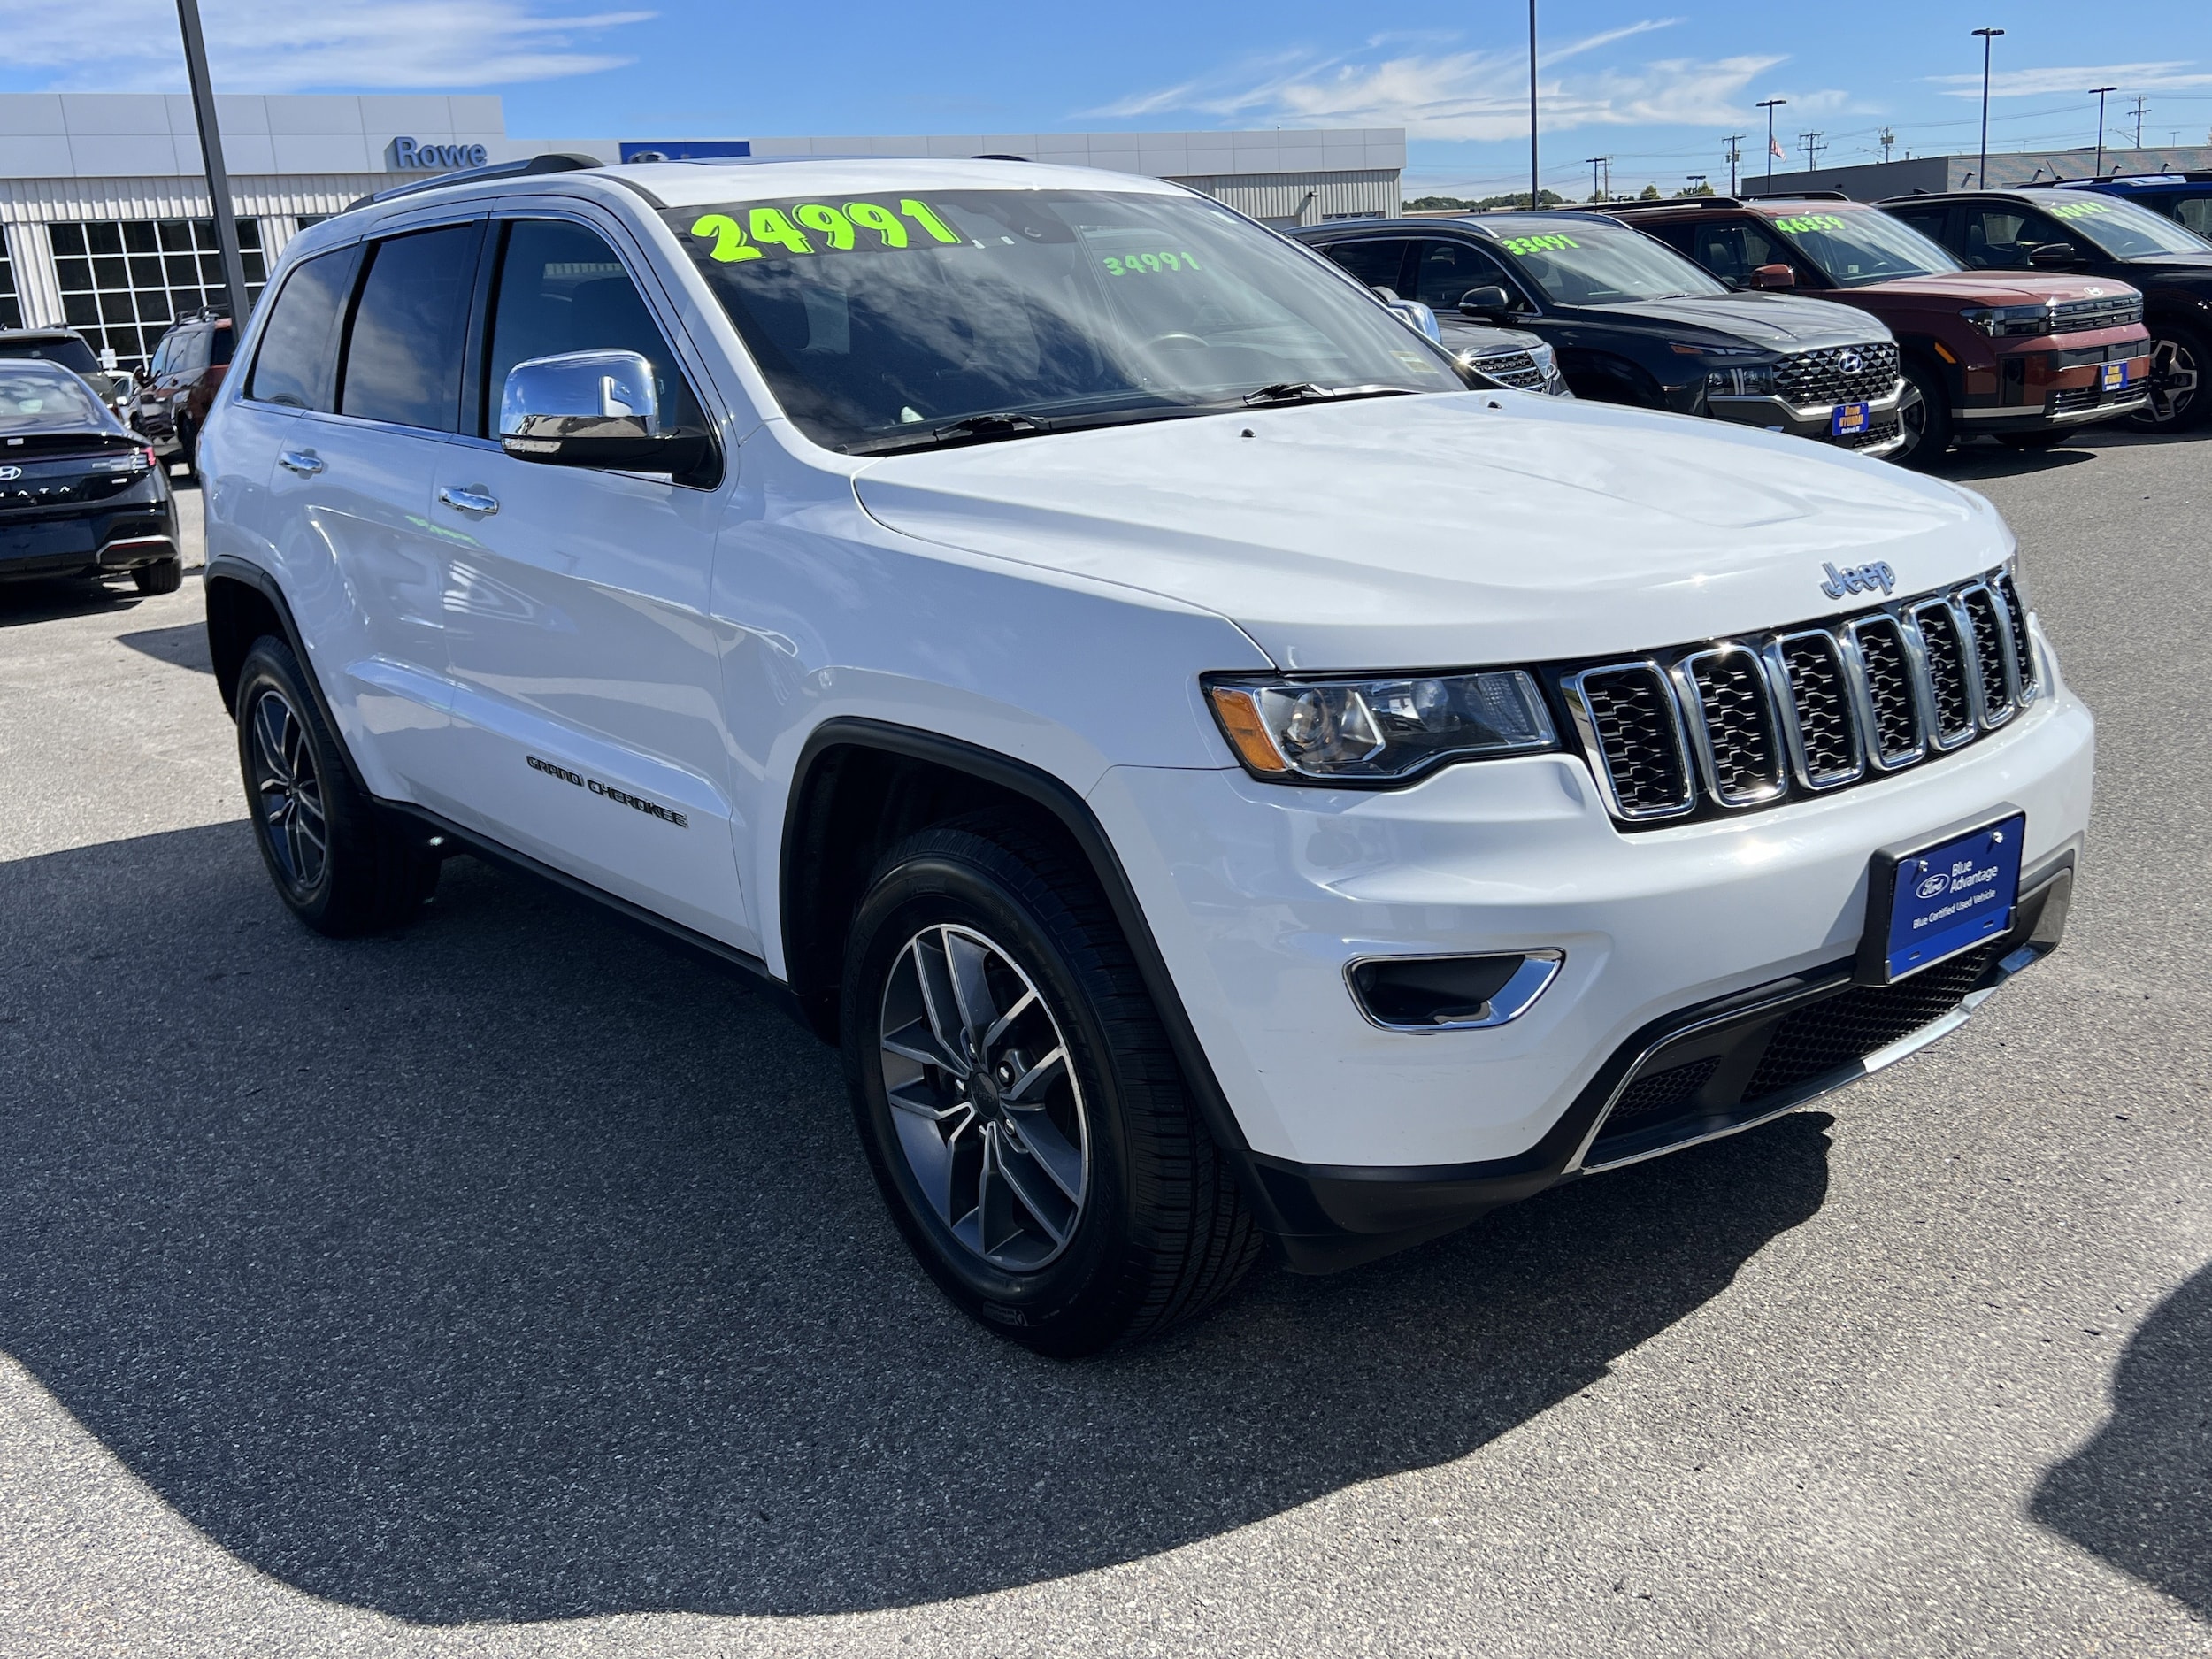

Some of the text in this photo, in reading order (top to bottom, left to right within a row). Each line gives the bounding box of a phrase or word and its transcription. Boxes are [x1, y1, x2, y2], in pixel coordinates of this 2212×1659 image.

[396, 136, 488, 167] Rowe
[690, 198, 962, 265] 24991
[1774, 210, 1847, 234] 46359
[1502, 234, 1580, 256] 33491
[1103, 250, 1202, 276] 34991
[1820, 559, 1895, 599] Jeep
[526, 755, 688, 828] GRAND CHEROKEE
[1949, 865, 1998, 894] Advantage
[1952, 860, 1972, 877] Blue
[1920, 876, 1946, 896] Ford
[1913, 888, 1996, 929] Blue Certified Used Vehicle
